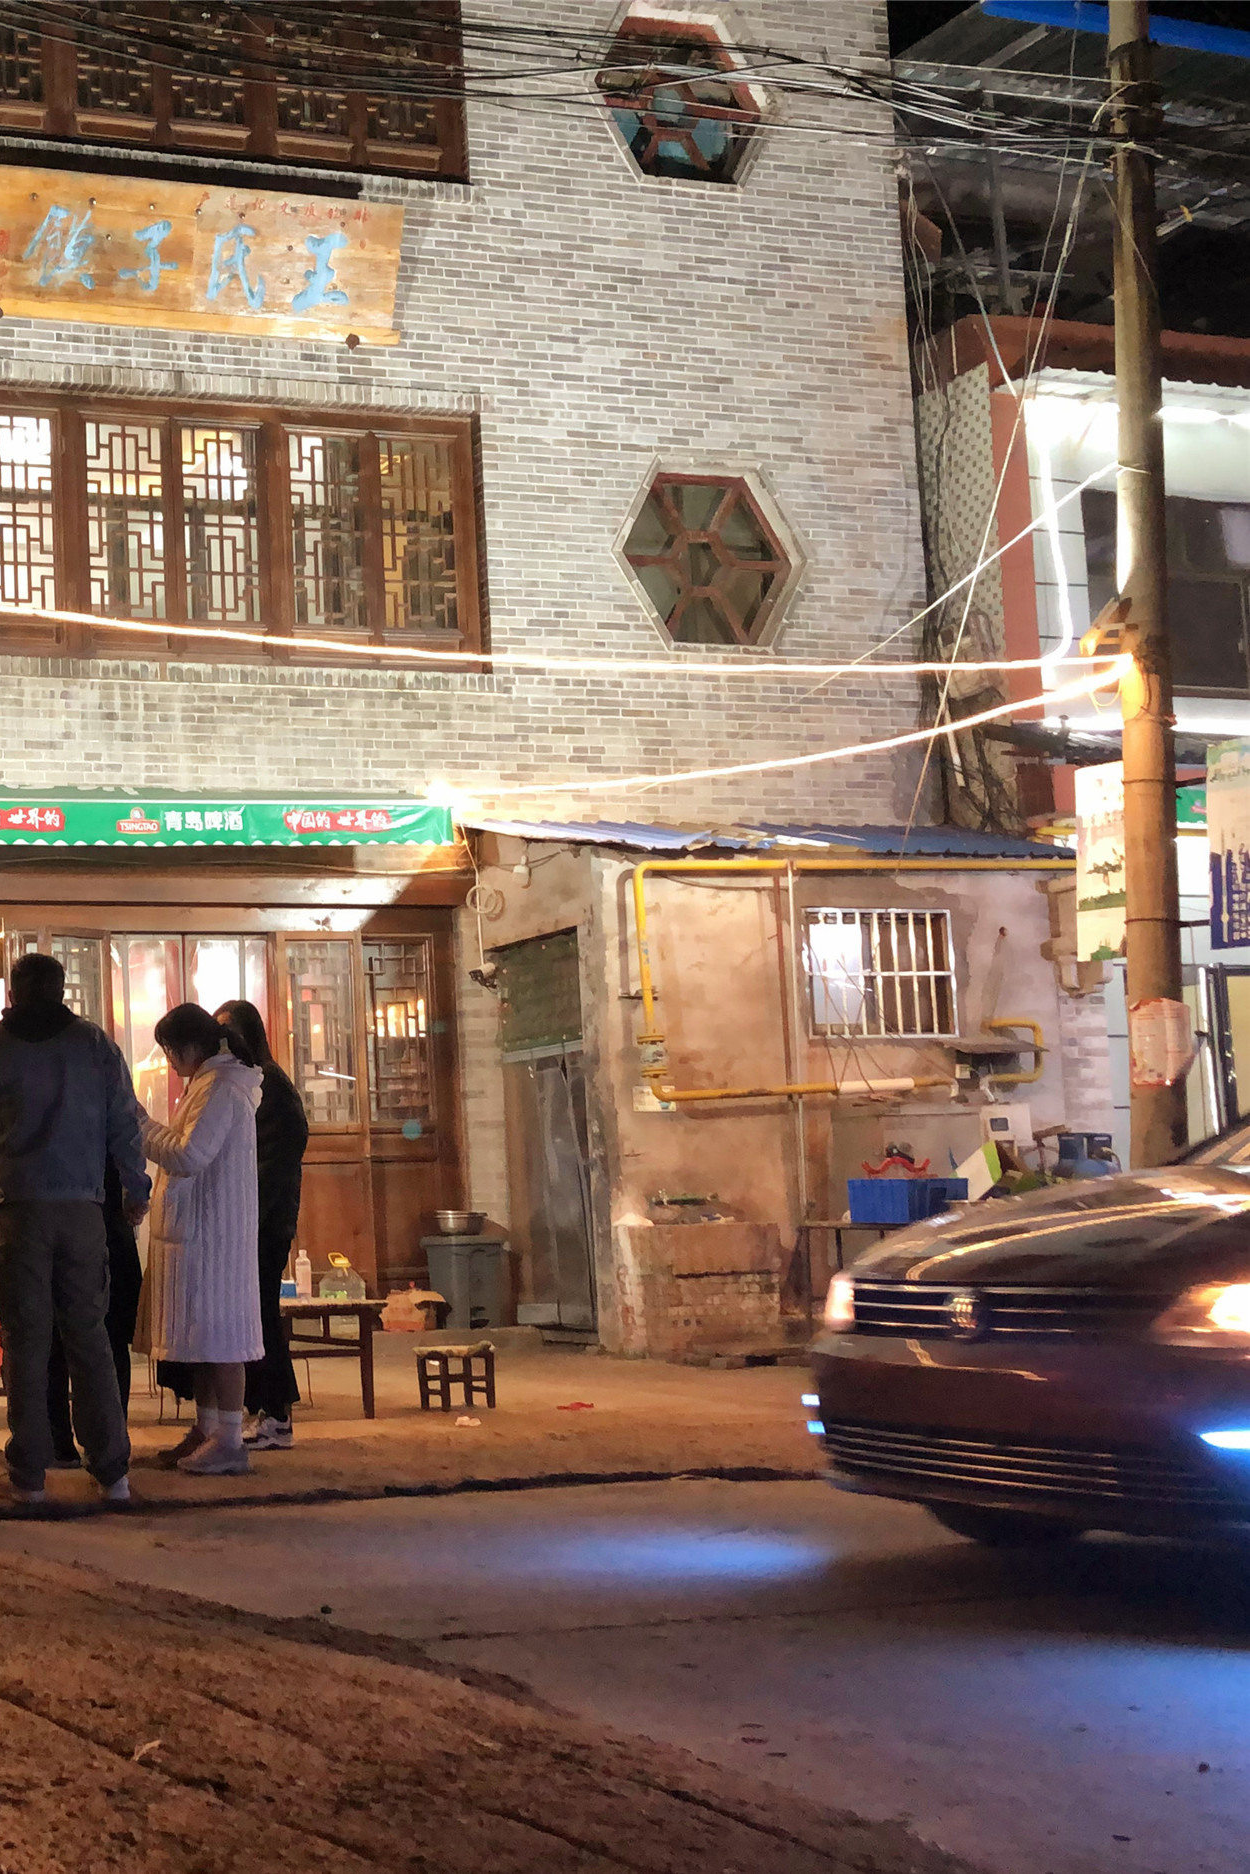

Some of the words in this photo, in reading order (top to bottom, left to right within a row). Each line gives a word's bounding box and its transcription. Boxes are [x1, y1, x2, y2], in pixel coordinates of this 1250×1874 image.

[7, 807, 60, 829] 世界的
[119, 822, 158, 831] TSINGTAO
